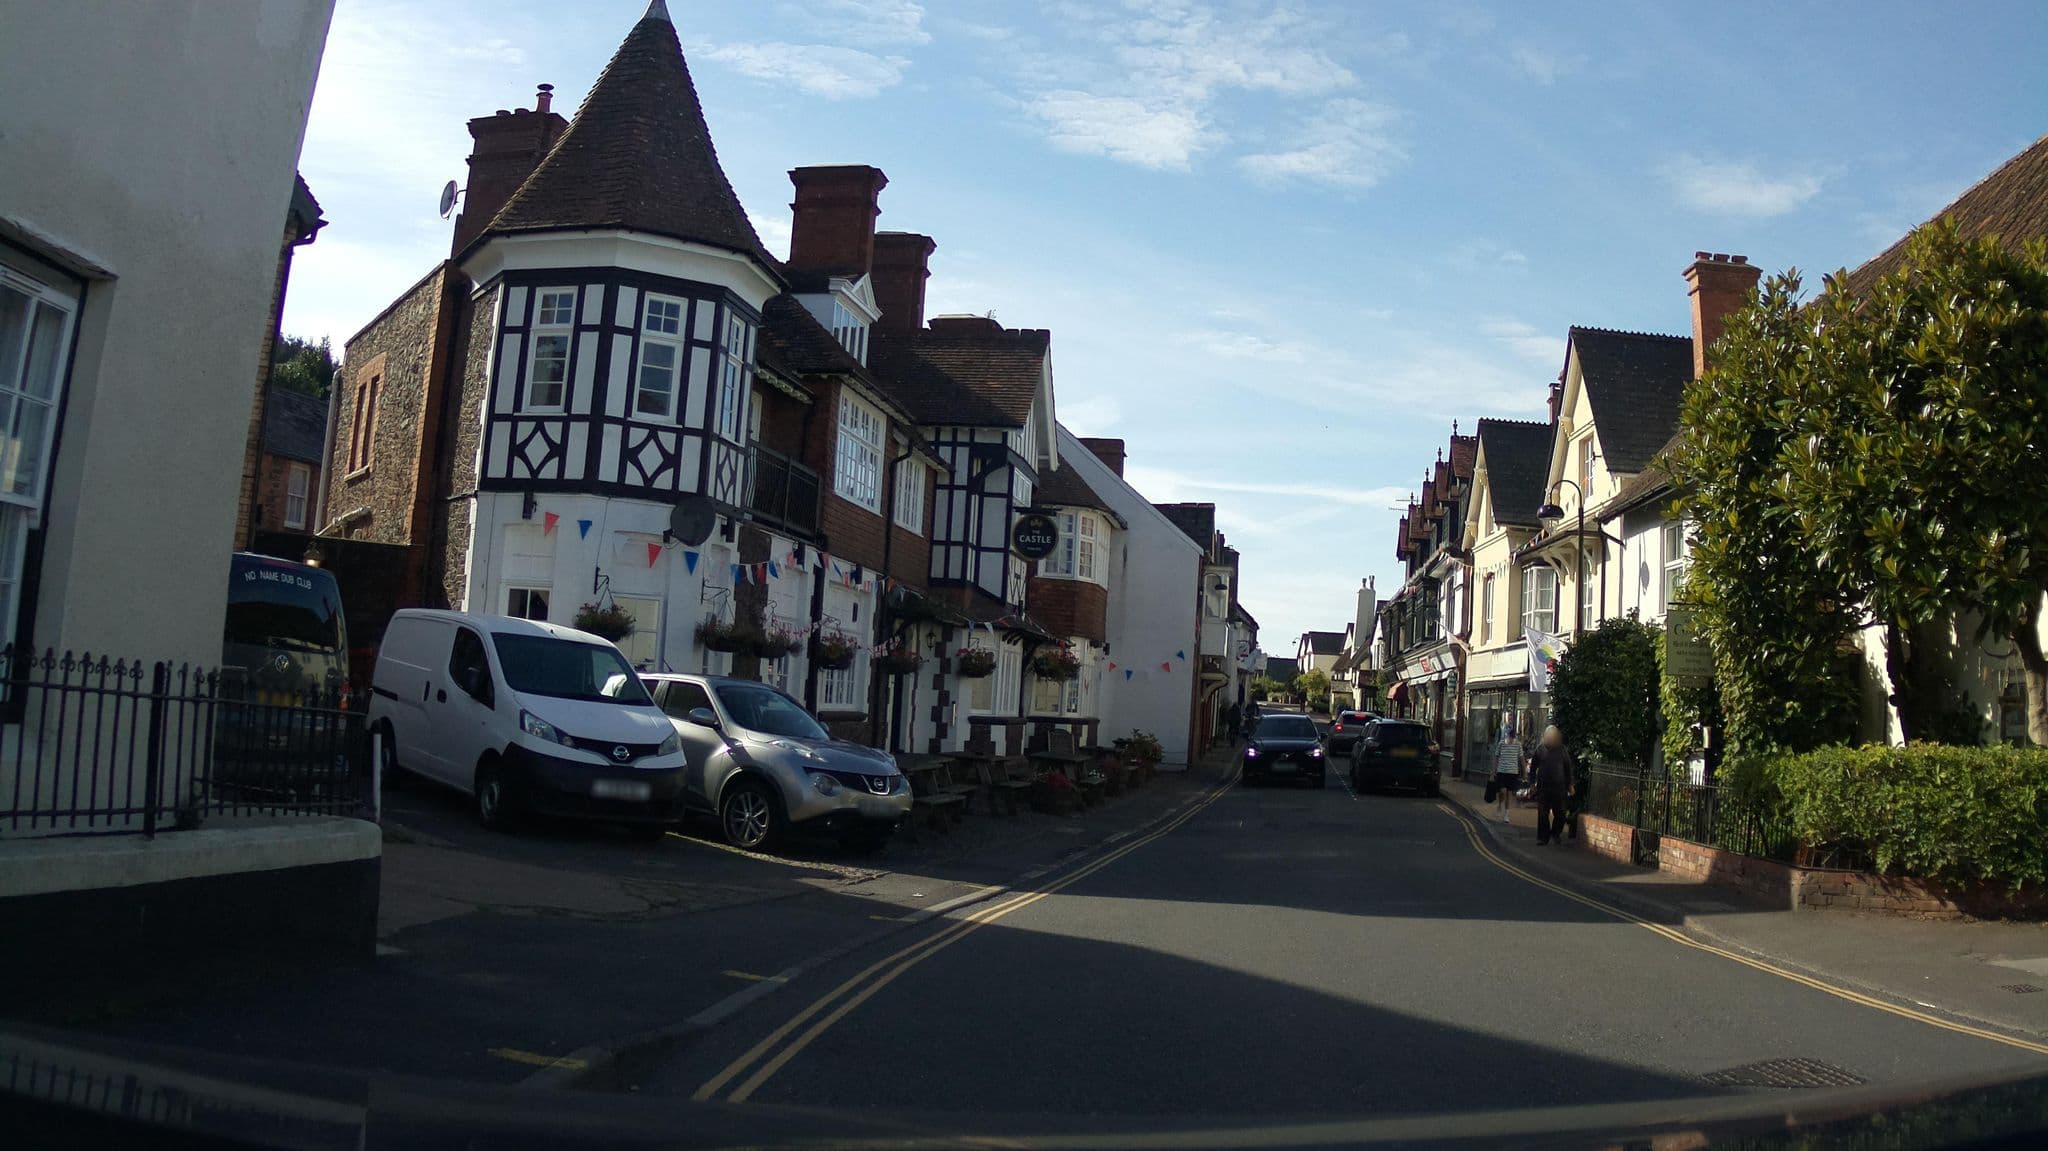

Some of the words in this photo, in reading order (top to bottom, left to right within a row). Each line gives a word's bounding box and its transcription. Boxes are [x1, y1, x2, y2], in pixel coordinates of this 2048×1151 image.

[1019, 534, 1052, 544] CASTLE
[244, 570, 257, 582] NO
[260, 568, 280, 582] NAME
[281, 573, 295, 585] DUB
[296, 576, 312, 590] CLUB
